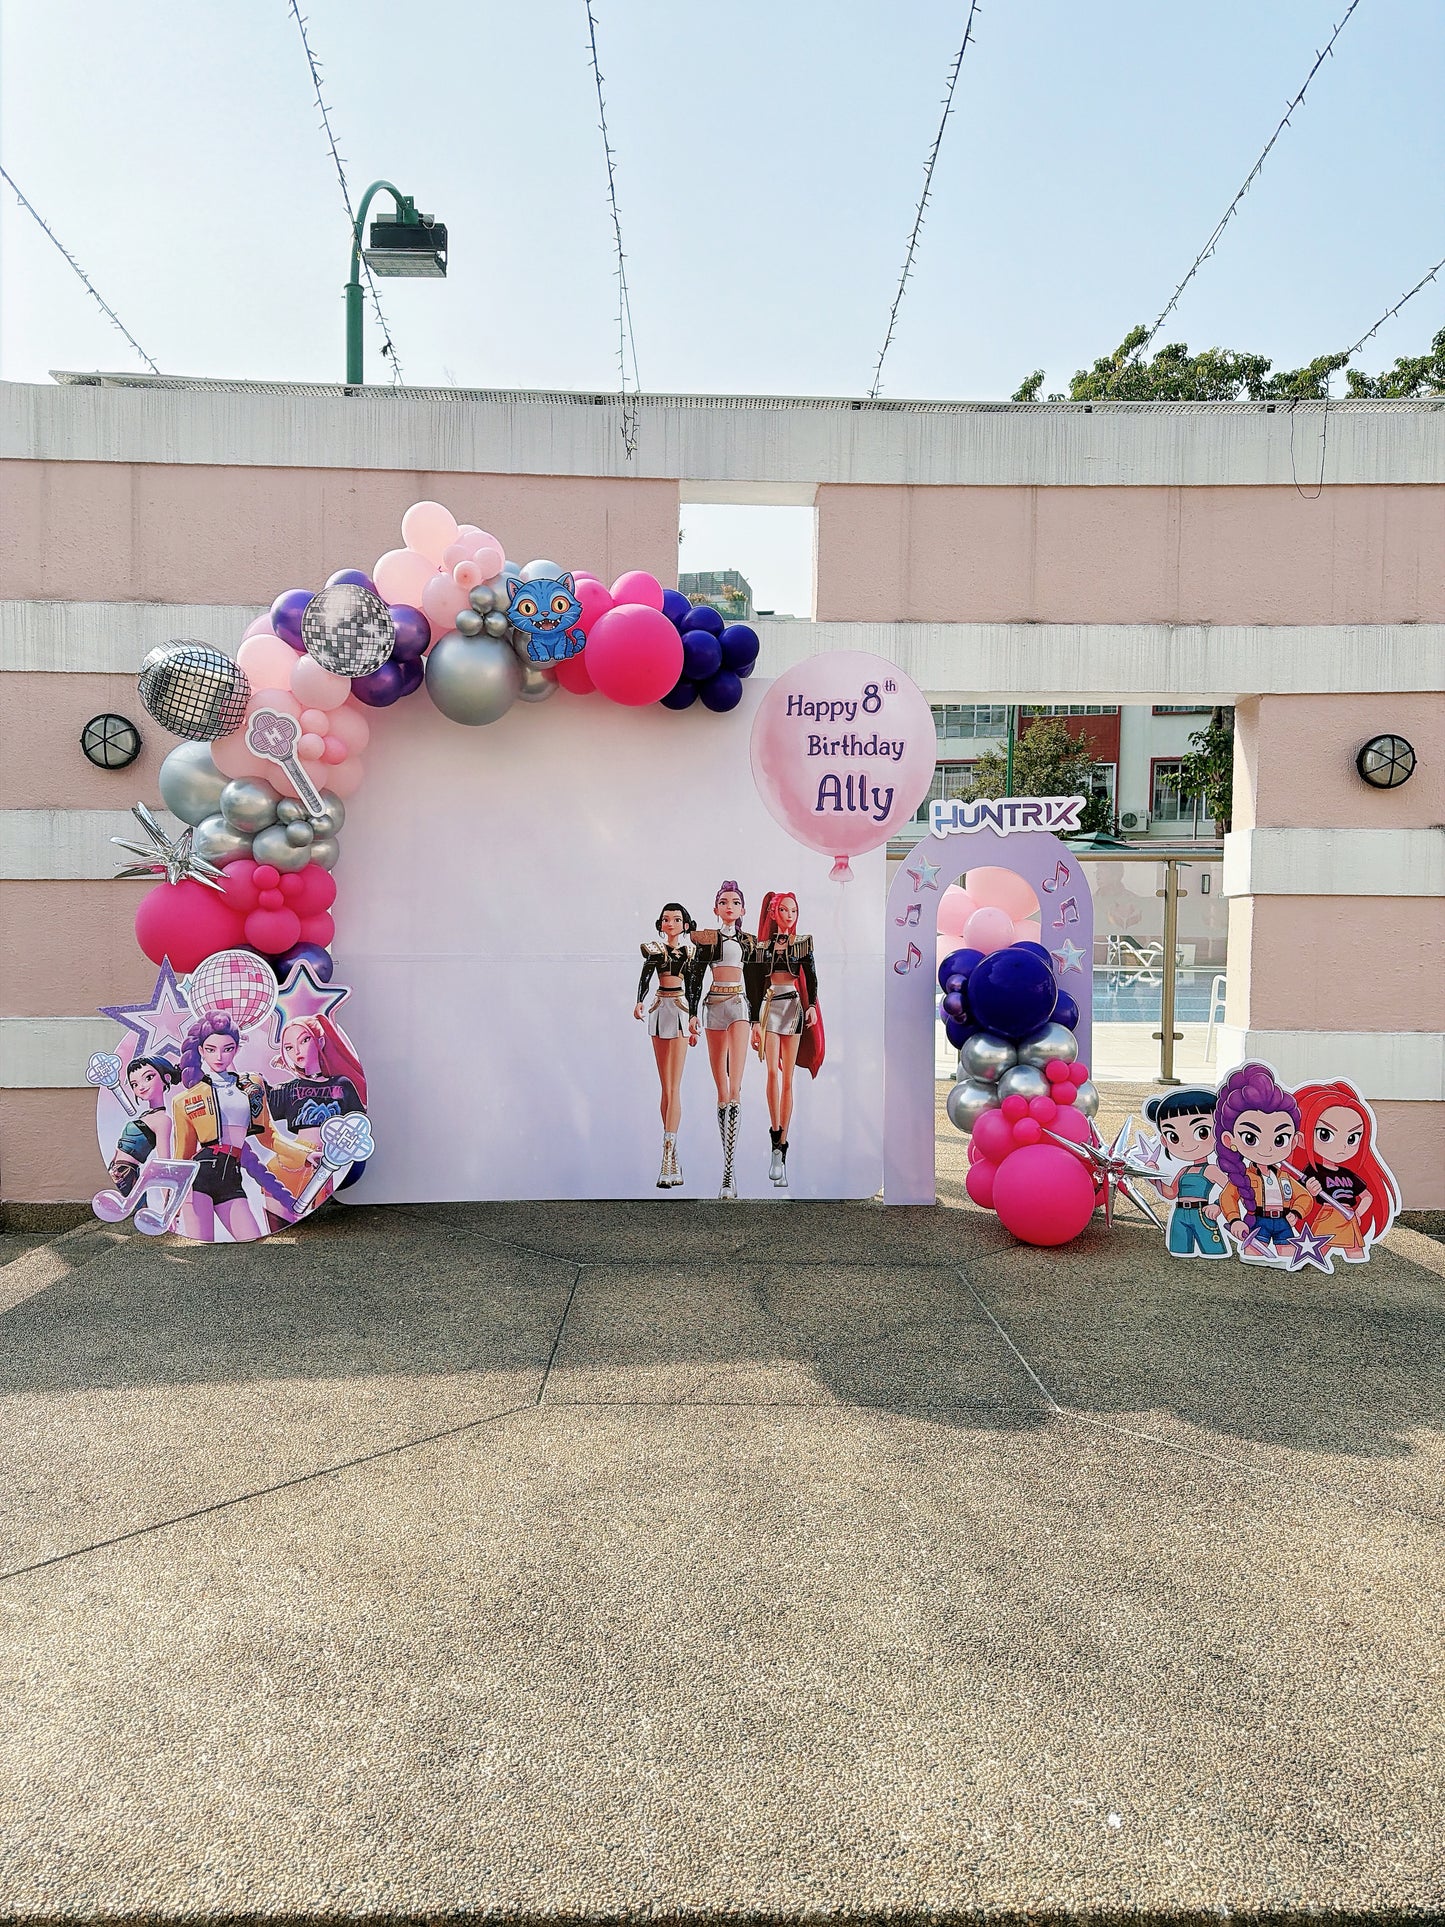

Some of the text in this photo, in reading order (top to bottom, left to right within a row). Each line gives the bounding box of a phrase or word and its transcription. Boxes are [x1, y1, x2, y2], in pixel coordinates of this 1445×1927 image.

[786, 694, 858, 721] Happy
[807, 734, 905, 761] Birthday
[815, 773, 895, 821] Ally
[935, 801, 1080, 833] HUNTRIX
